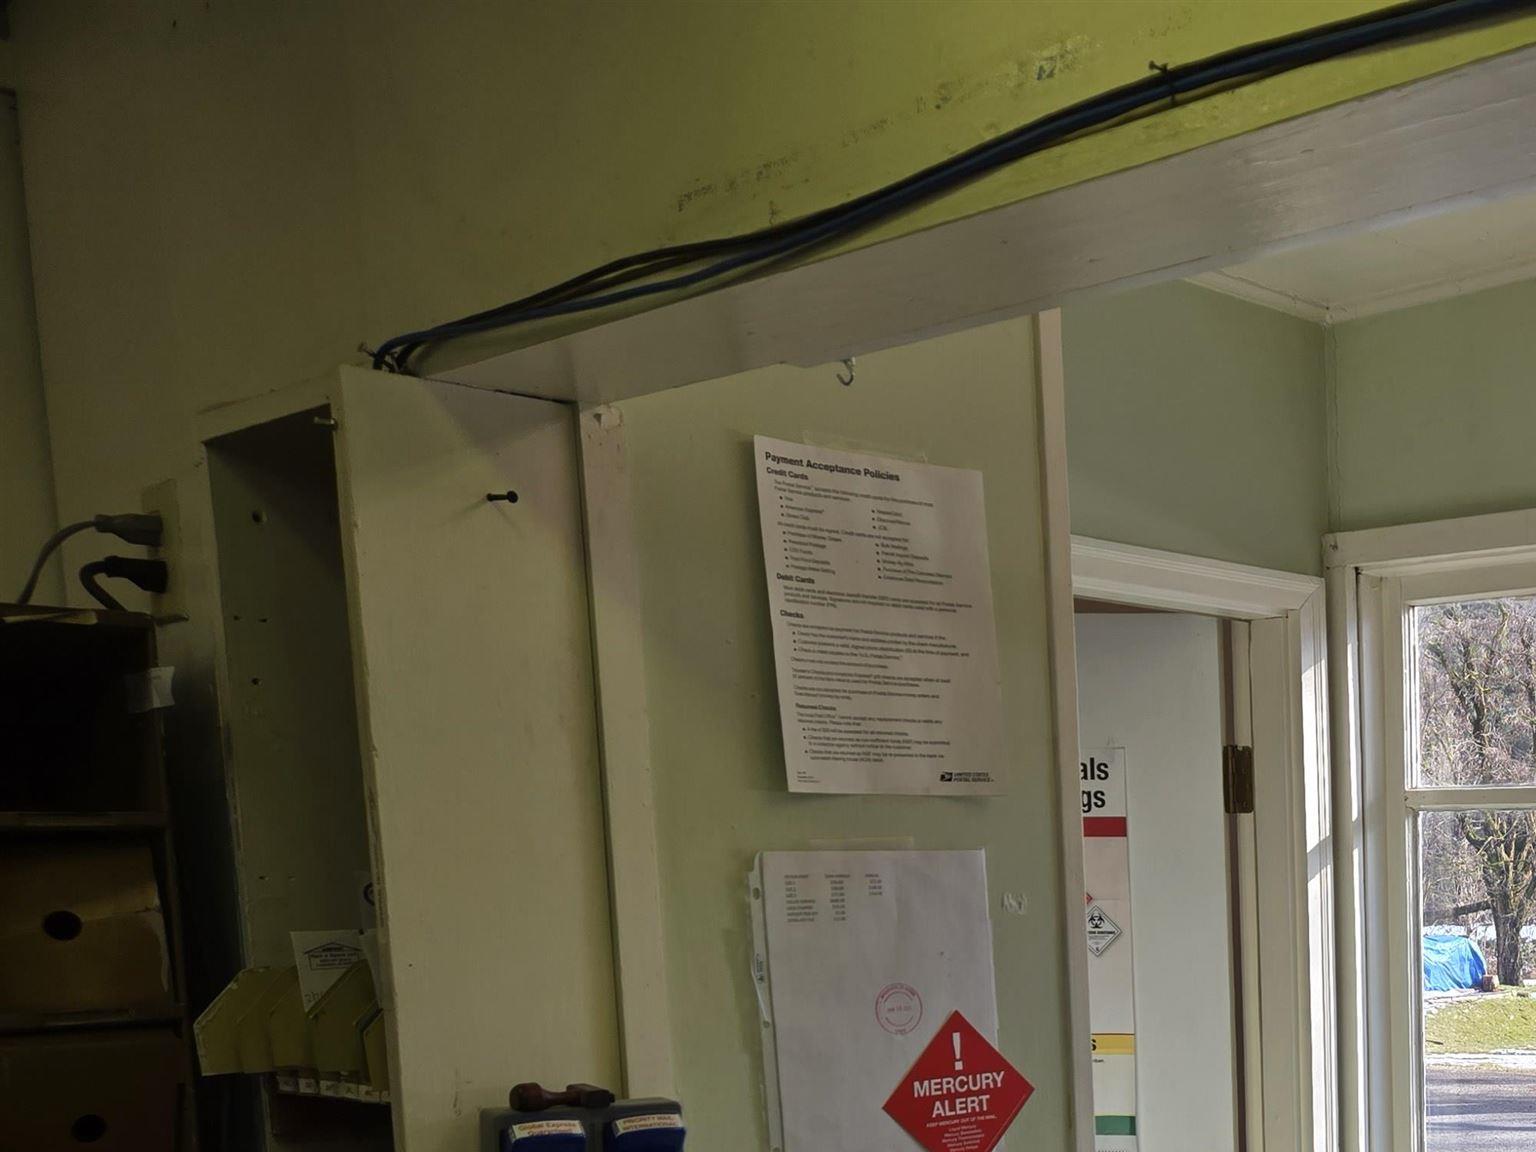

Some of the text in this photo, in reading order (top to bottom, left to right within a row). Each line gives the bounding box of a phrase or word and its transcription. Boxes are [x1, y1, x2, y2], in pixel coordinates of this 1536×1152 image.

[765, 451, 900, 482] Payment Acceptance Policies
[766, 467, 809, 480] Credit Cards
[776, 572, 815, 584] Debit Cards
[779, 609, 804, 620] Checks
[1080, 757, 1109, 780] als
[1082, 790, 1106, 813] gs
[913, 1071, 1005, 1098] MERCURY
[932, 1095, 990, 1118] ALERT
